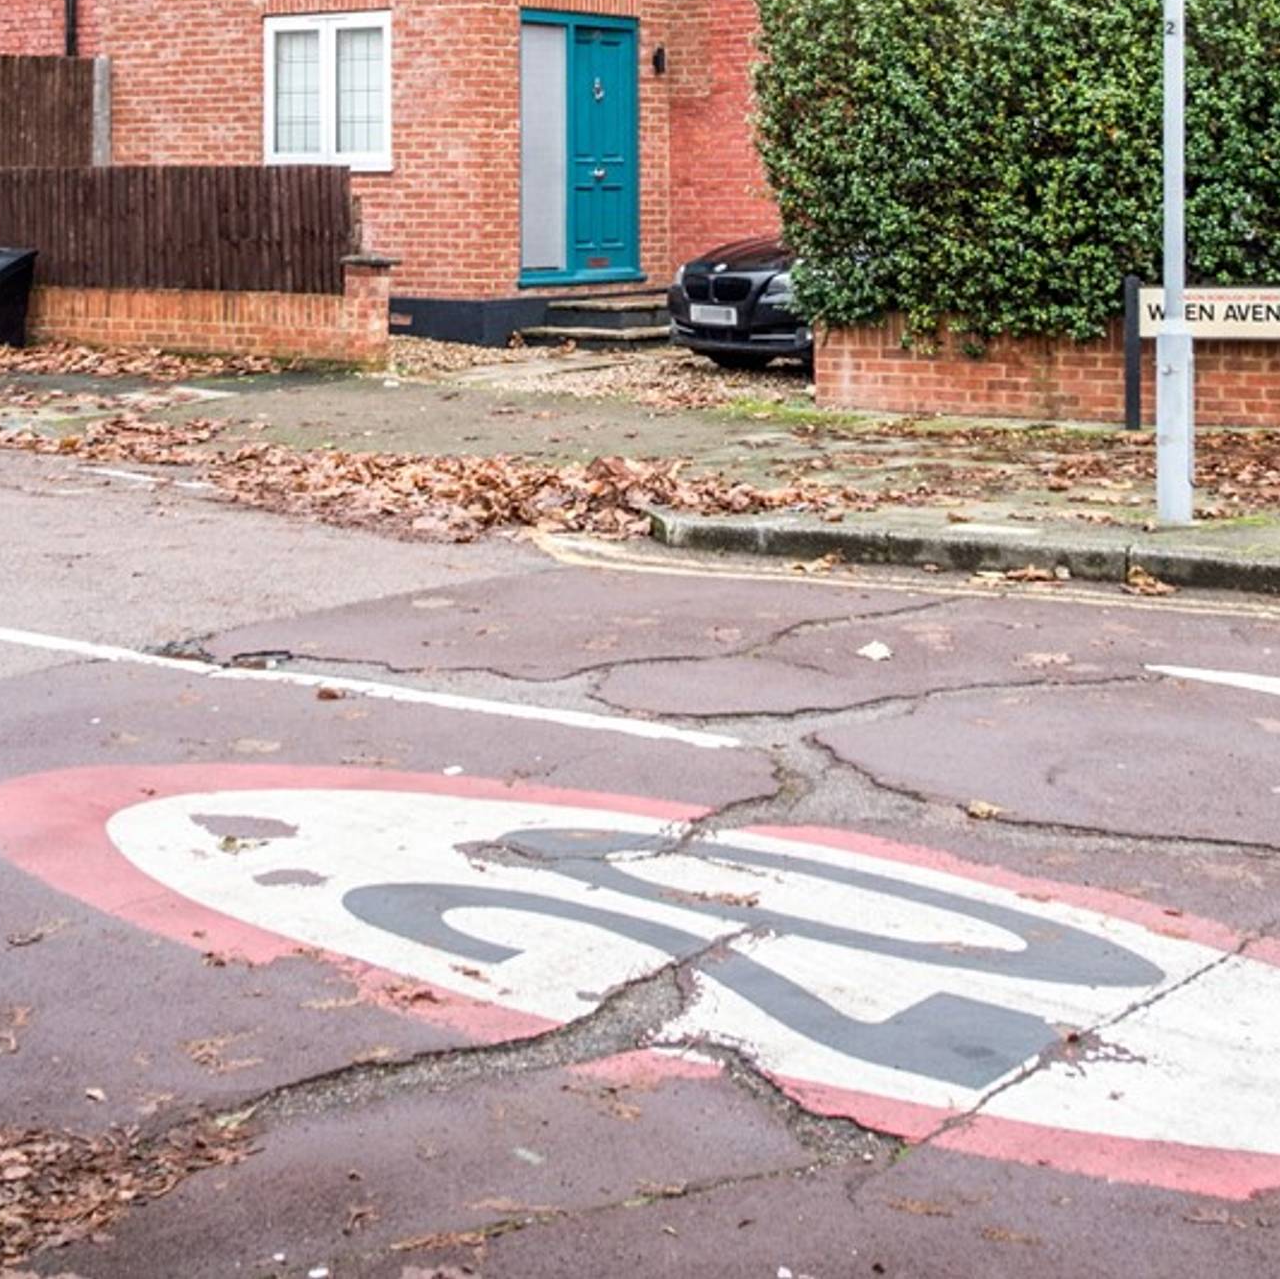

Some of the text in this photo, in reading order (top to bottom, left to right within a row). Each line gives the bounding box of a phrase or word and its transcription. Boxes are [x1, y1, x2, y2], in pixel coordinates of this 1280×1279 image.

[1166, 21, 1174, 35] 2
[1147, 303, 1214, 321] WEN
[342, 826, 1165, 1092] 20
